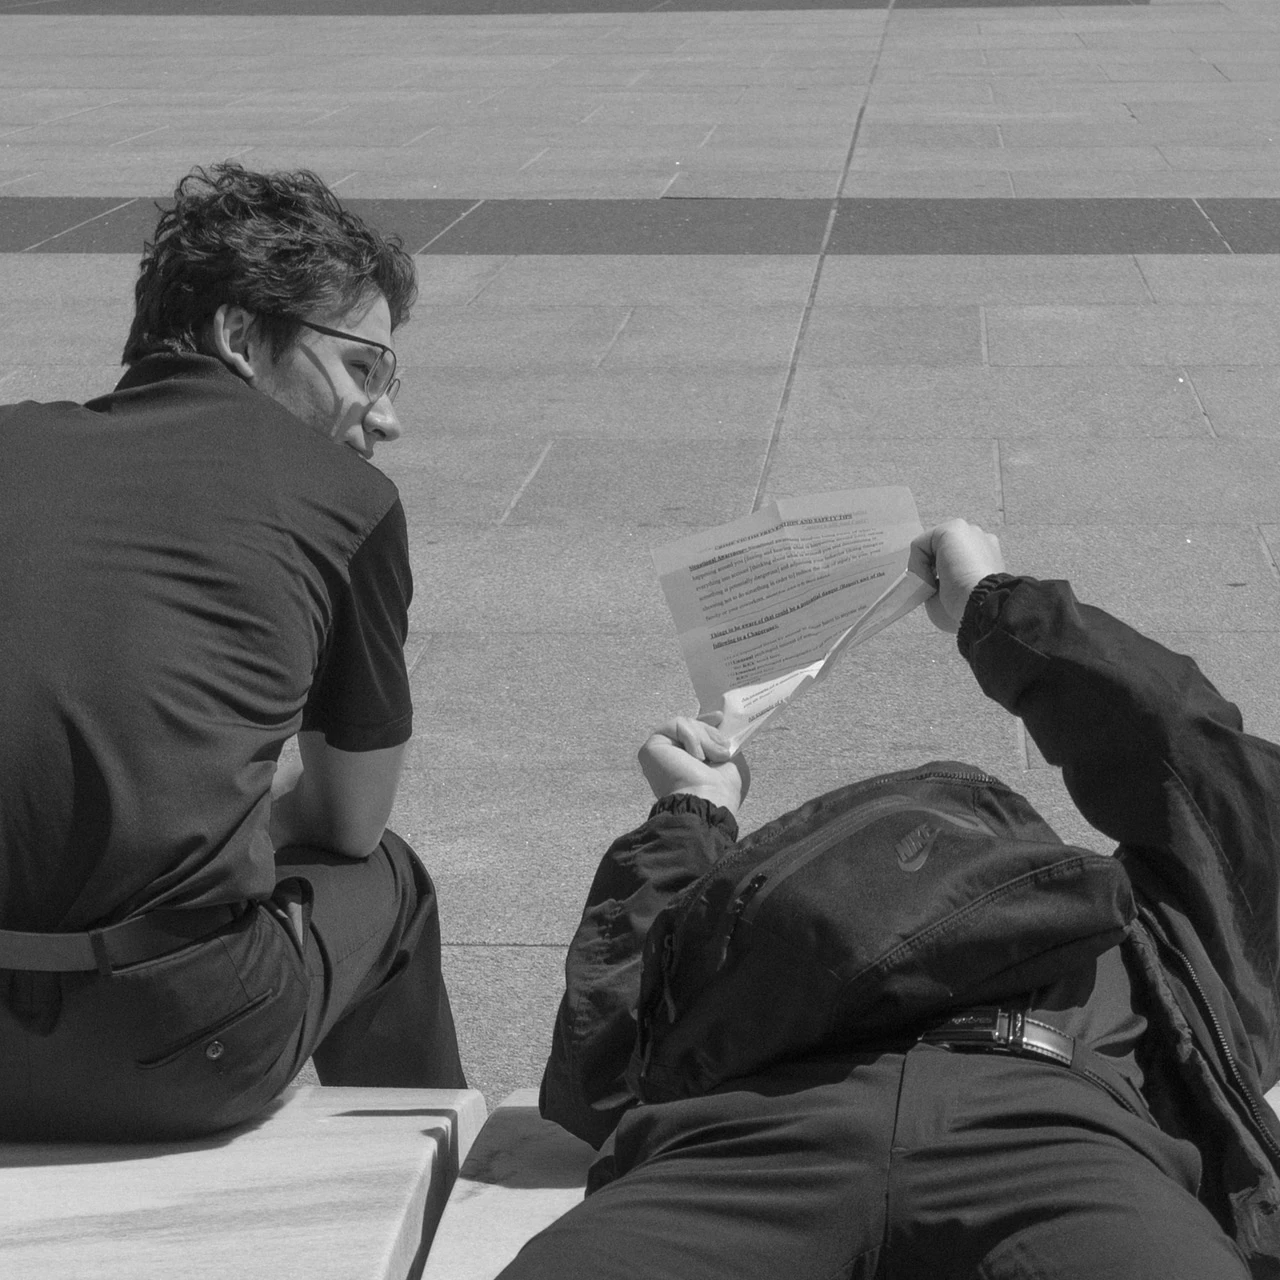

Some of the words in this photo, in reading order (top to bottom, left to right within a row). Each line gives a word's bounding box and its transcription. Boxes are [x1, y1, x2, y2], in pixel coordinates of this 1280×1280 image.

[759, 520, 798, 536] PREVENTION
[814, 515, 837, 523] SAFETY
[688, 556, 716, 572] Situational
[691, 569, 716, 580] happening
[717, 562, 733, 572] around
[696, 579, 721, 591] everything
[730, 567, 748, 579] account
[698, 589, 723, 601] something
[728, 578, 753, 592] potentially
[702, 600, 724, 611] choosing
[744, 583, 769, 596] something
[775, 576, 787, 585] order
[710, 628, 728, 639] Things
[741, 619, 757, 630] aware
[774, 606, 788, 618] could
[800, 592, 820, 608] potential
[821, 586, 838, 598] danger
[712, 637, 736, 649] following
[894, 823, 930, 862] NIKE
